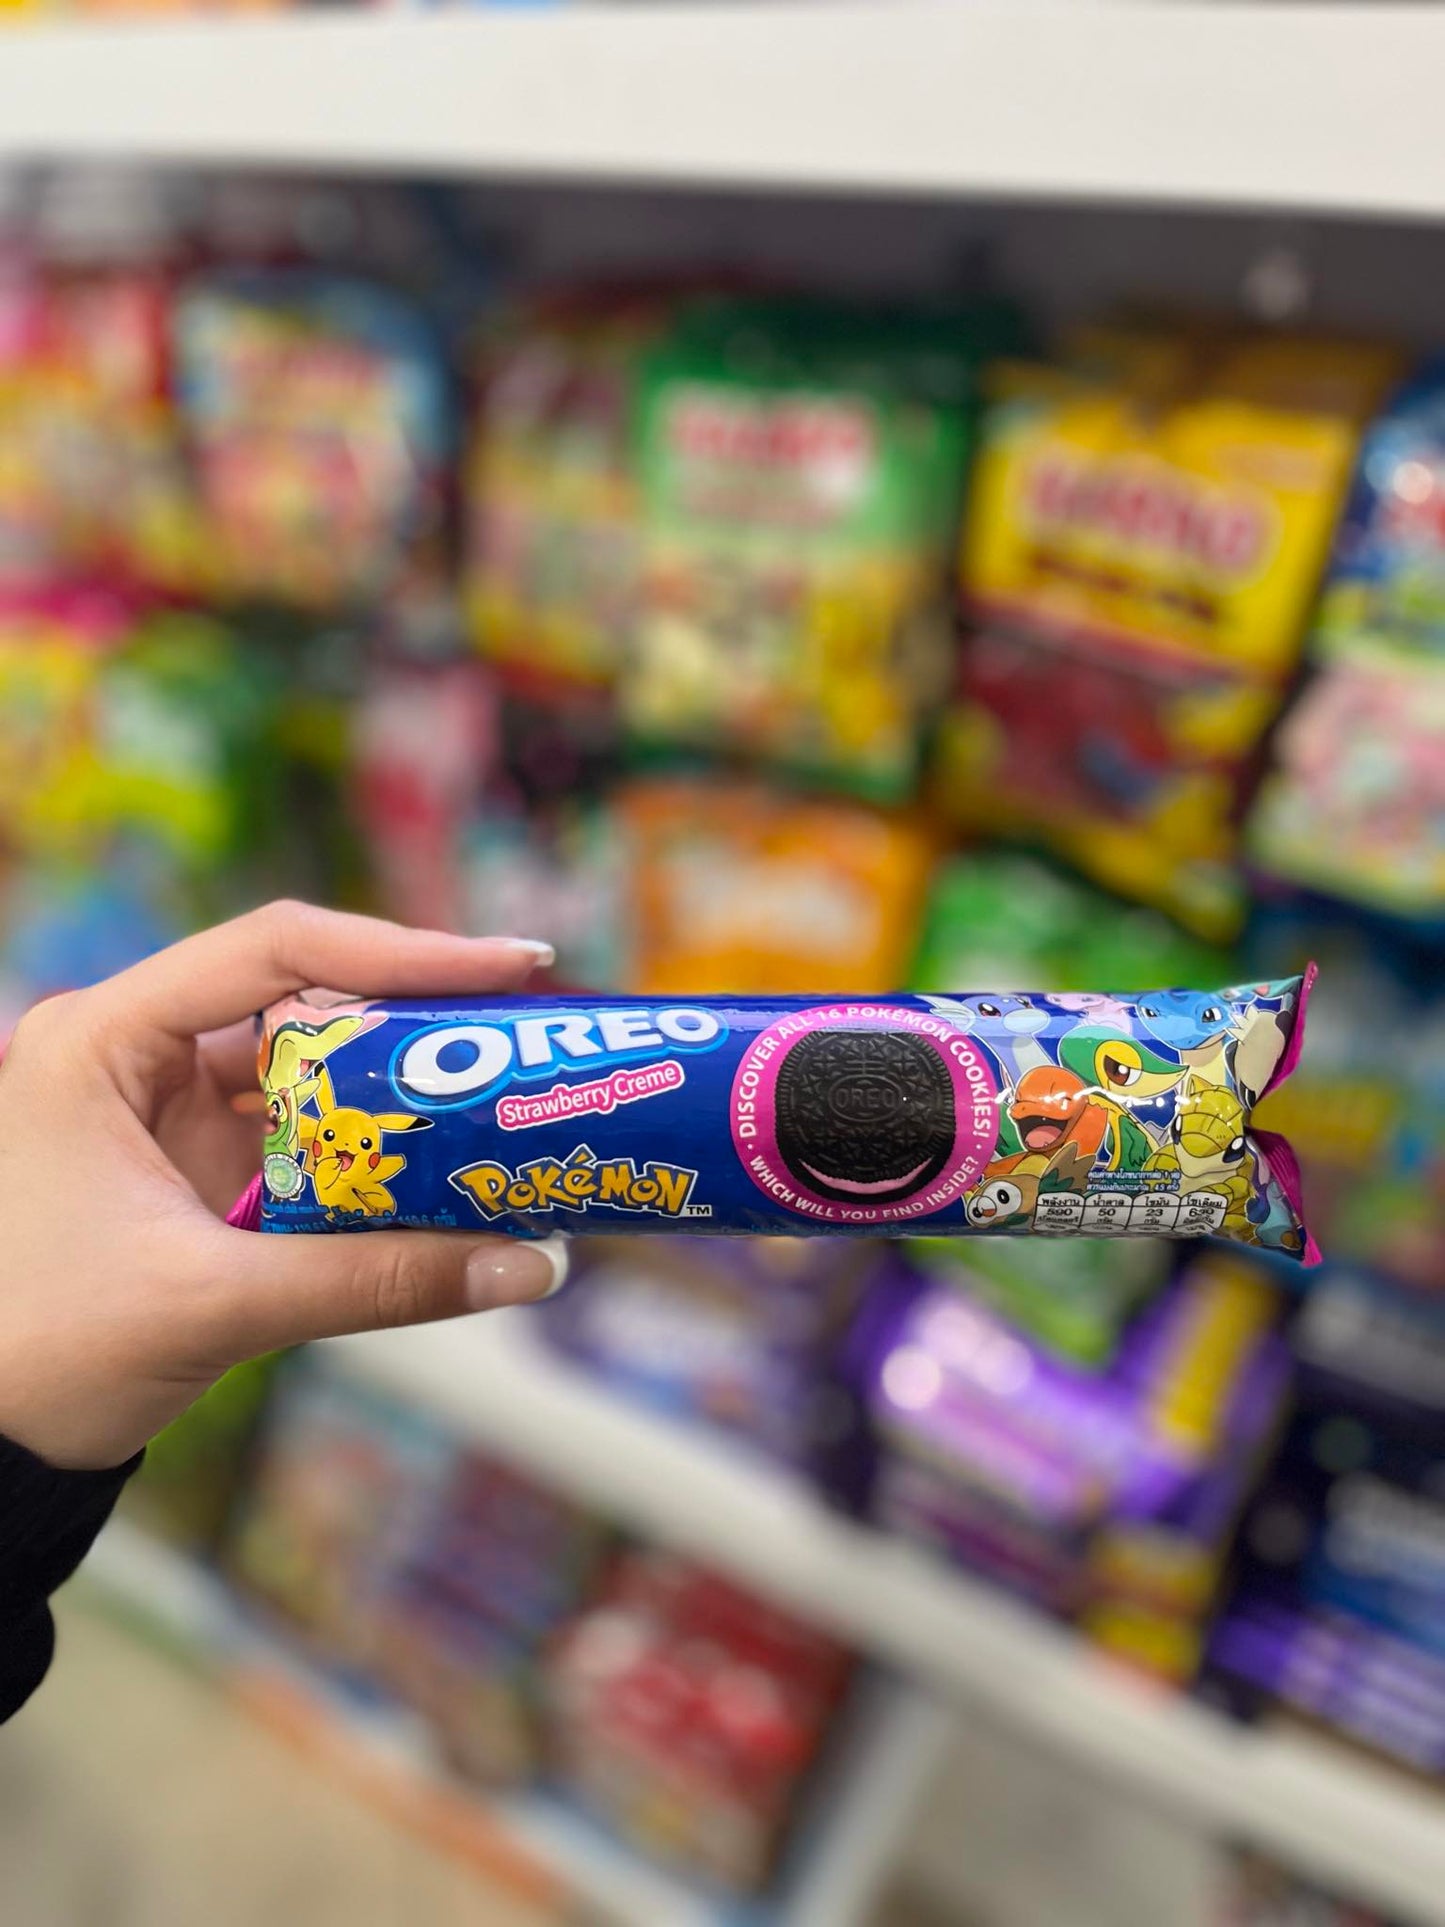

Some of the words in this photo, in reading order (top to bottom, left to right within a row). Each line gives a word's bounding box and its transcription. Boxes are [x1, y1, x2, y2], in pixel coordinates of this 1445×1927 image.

[402, 1008, 720, 1096] OREO
[737, 1036, 781, 1139] DISCOVER
[777, 1015, 815, 1040] ALL
[815, 1007, 843, 1021] 16
[846, 1006, 953, 1043] POKÉMON
[949, 1040, 992, 1138] COOKIES!
[502, 1084, 611, 1125] Strawberry
[613, 1065, 677, 1098] Creme
[835, 1087, 896, 1109] OREO
[749, 1155, 795, 1203] WHICH
[795, 1197, 835, 1219] WILL
[840, 1209, 877, 1220] YOU
[882, 1202, 925, 1219] FIND
[926, 1155, 980, 1206] INSIDE?
[1097, 1208, 1116, 1217] 50
[1145, 1208, 1164, 1217] 23
